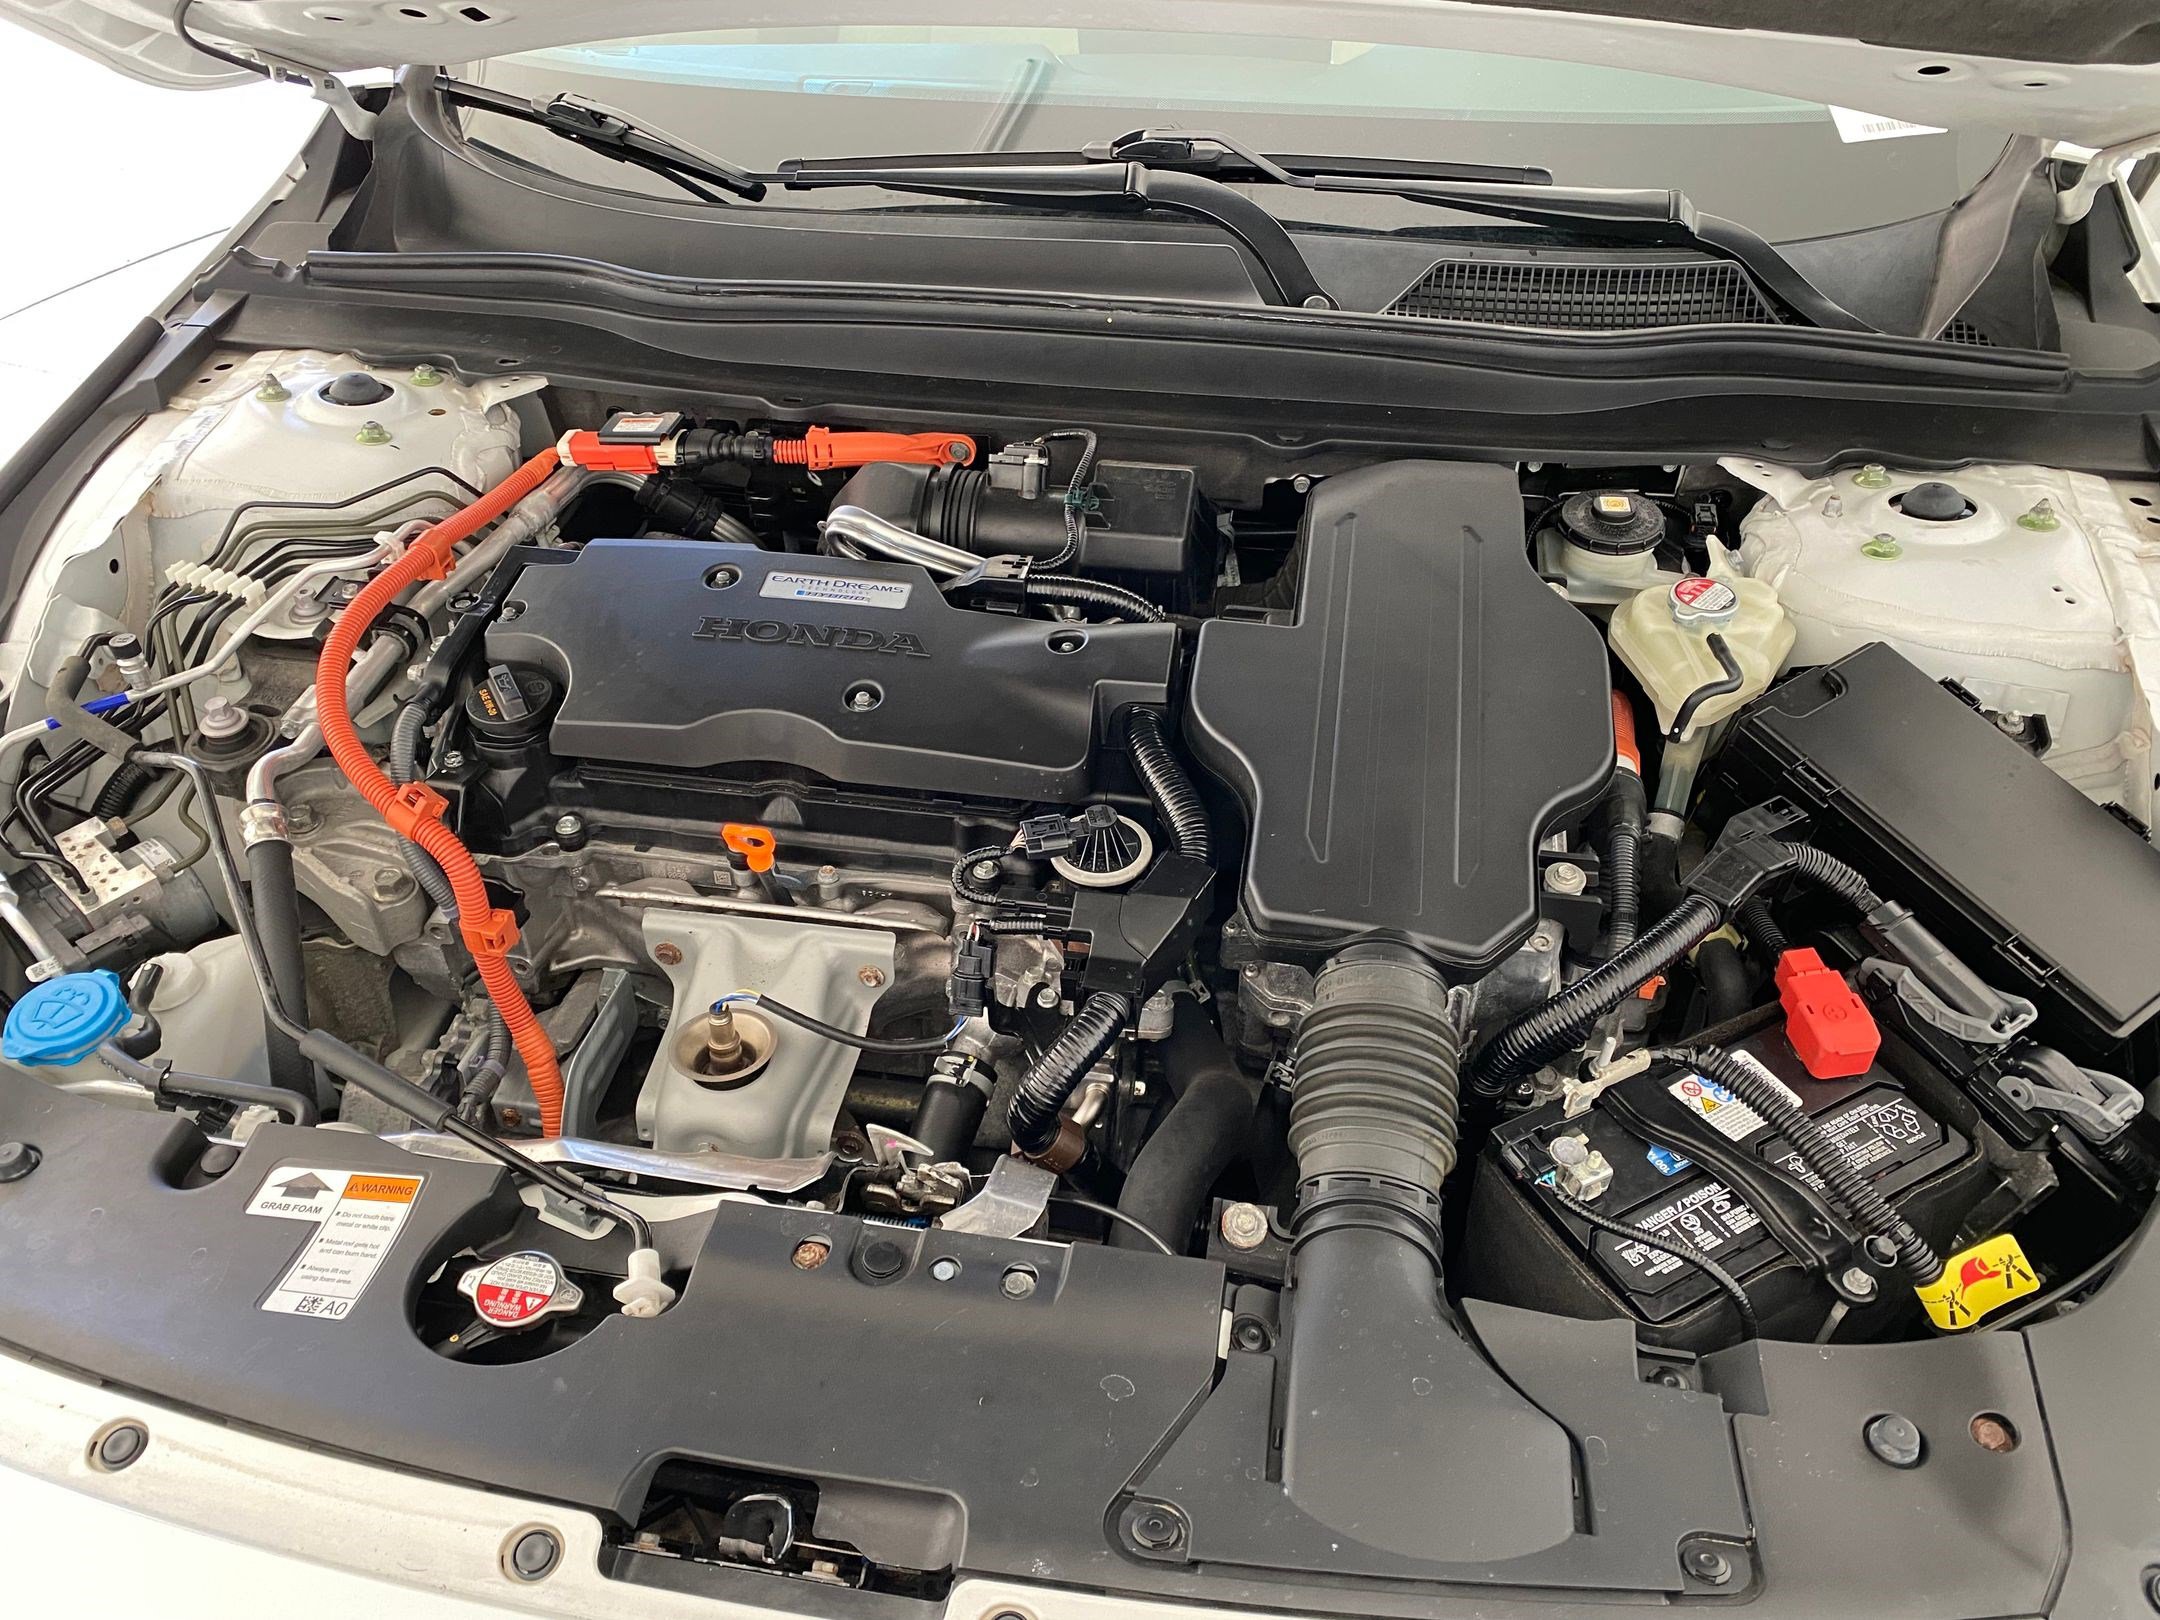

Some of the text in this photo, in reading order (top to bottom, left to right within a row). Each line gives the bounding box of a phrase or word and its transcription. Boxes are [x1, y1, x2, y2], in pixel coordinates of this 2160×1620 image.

[771, 575, 905, 594] EARTH DREAMS
[801, 586, 870, 595] TECHNOLOGY
[692, 615, 932, 657] HONDA
[479, 688, 490, 701] SAE
[1835, 1139, 1847, 1148] GET
[1844, 1141, 1857, 1151] FAST
[1655, 1159, 1670, 1174] 100
[361, 1183, 414, 1196] WARNING
[260, 1201, 323, 1214] GRAB FOAM
[325, 1238, 343, 1246] Metal
[319, 1300, 348, 1316] A0
[483, 1299, 521, 1311] WARNUNG
[488, 1308, 519, 1318] DANGER
